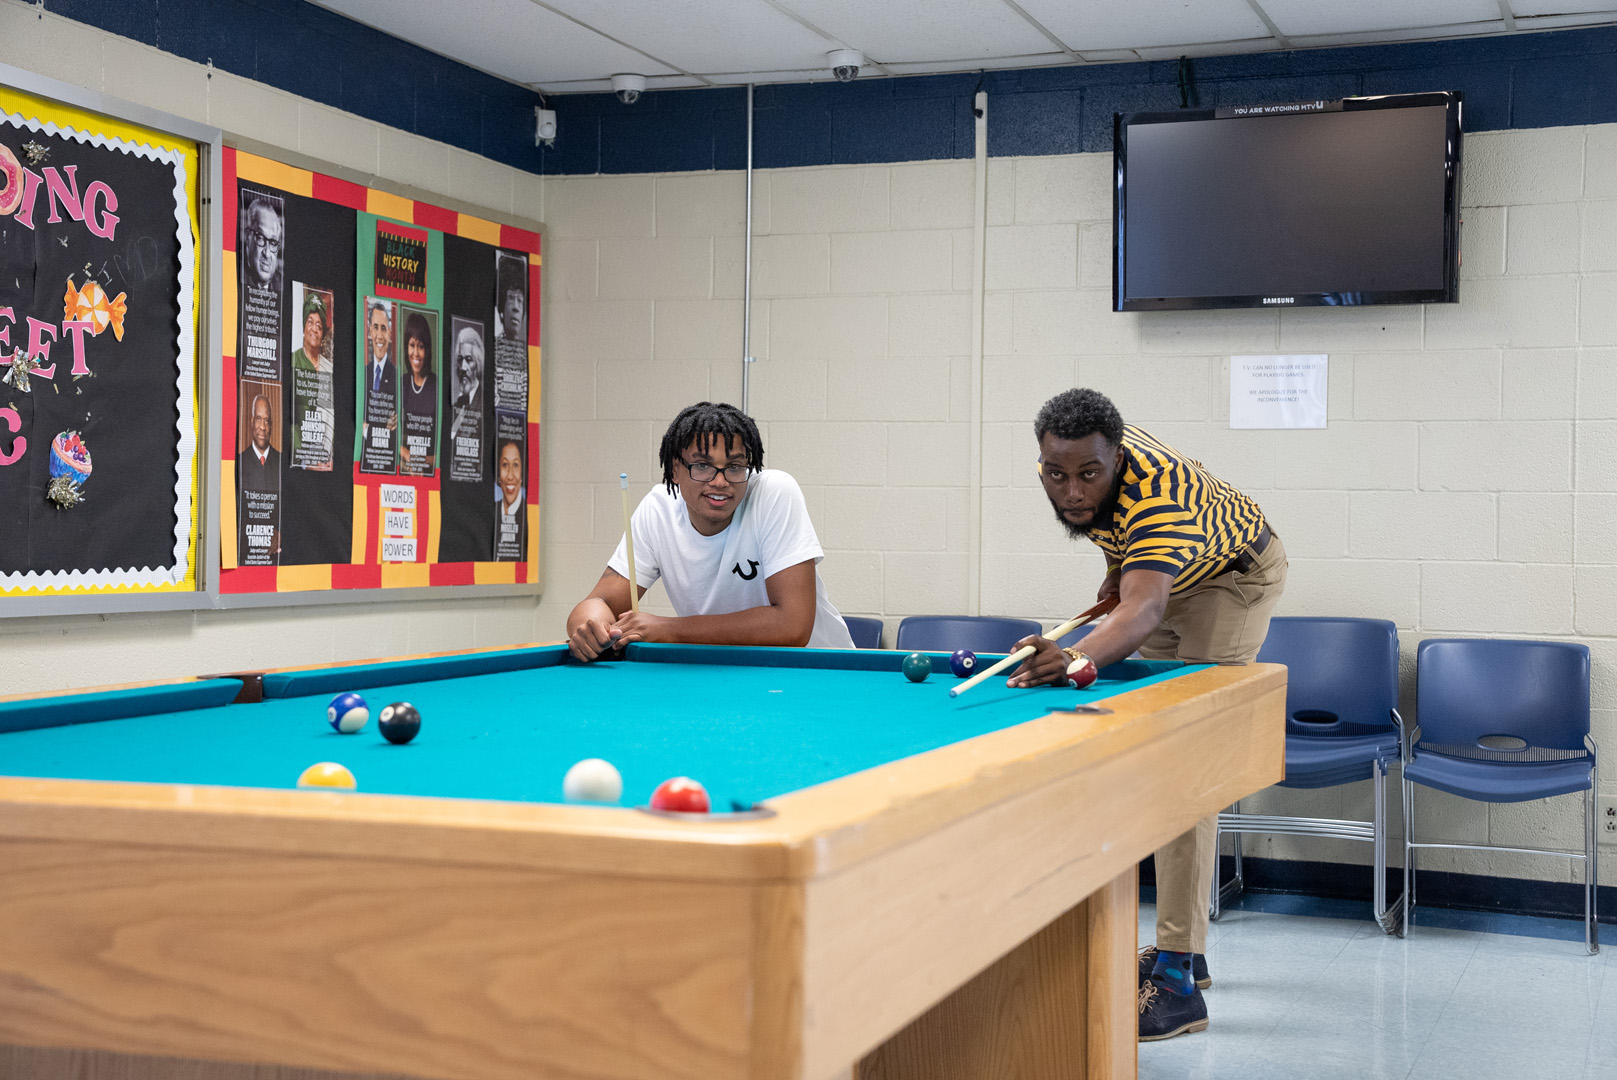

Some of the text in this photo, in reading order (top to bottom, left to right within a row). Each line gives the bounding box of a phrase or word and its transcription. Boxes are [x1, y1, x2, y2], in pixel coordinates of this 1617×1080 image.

[386, 240, 415, 258] BLACK
[383, 254, 419, 273] HISTORY
[386, 268, 415, 284] MONTH
[256, 306, 267, 314] human
[248, 335, 276, 350] THURGOOD
[247, 346, 276, 361] MARSHALL
[305, 410, 322, 421] ELLEN
[301, 420, 326, 433] JOHNSON
[372, 427, 390, 438] BARACK
[301, 431, 324, 443] SIRLEAF
[372, 437, 389, 448] OBAMA
[407, 435, 431, 447] MICHELLE
[456, 436, 480, 448] FREDERICK
[410, 446, 427, 456] OBAMA
[456, 446, 479, 457] DOUGLASS
[250, 491, 260, 500] takes
[264, 493, 277, 502] person
[383, 489, 414, 504] WORDS
[247, 501, 256, 509] with
[260, 502, 274, 510] mission
[388, 517, 409, 529] HAVE
[246, 524, 274, 536] CLARENCE
[248, 536, 271, 547] THOMAS
[384, 543, 413, 557] POWER
